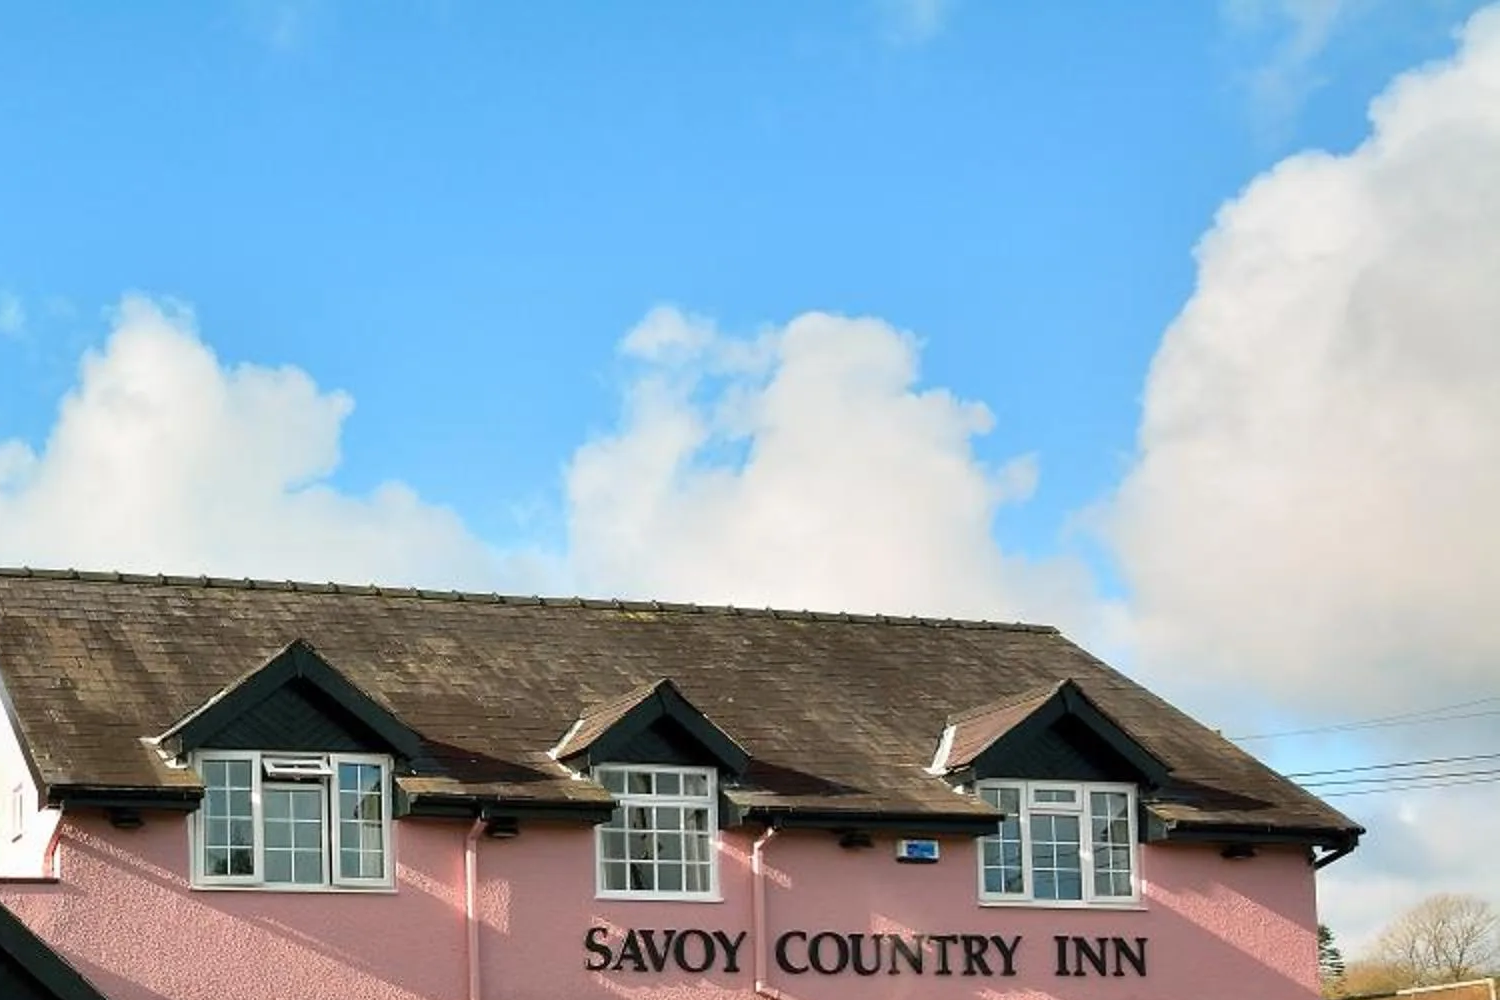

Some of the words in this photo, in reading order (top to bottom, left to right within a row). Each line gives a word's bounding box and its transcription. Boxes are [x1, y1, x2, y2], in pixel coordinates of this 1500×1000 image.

[585, 927, 747, 972] SAVOY
[775, 931, 1022, 976] COUNTRY
[1054, 936, 1148, 977] INN
